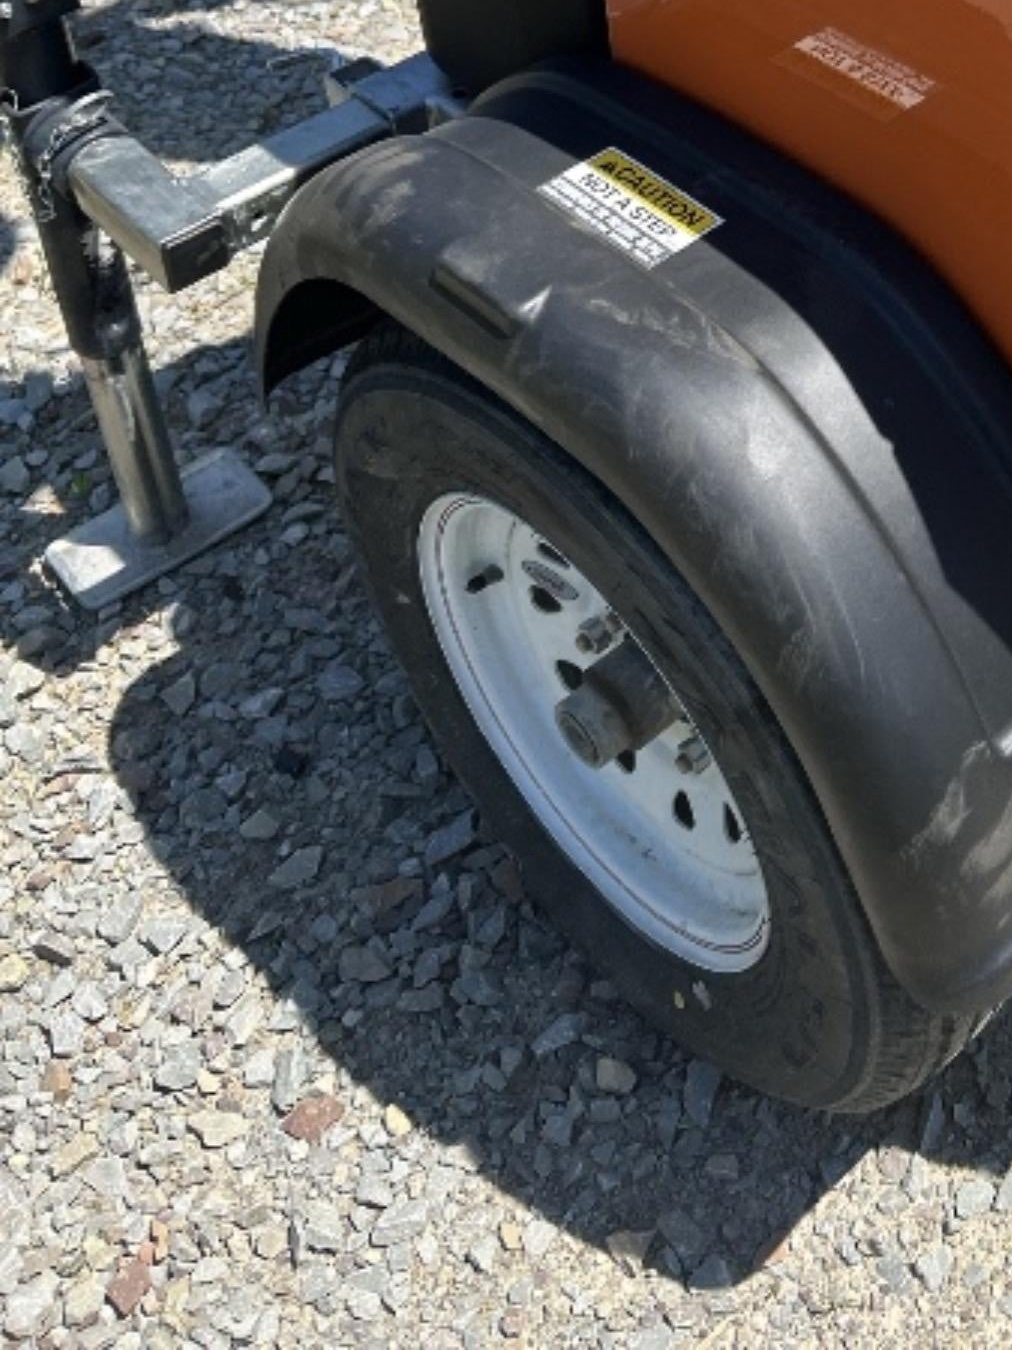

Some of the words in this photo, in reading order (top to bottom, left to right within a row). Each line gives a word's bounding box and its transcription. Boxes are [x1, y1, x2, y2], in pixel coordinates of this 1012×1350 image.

[578, 172, 622, 199] NOT
[614, 197, 631, 211] A
[629, 205, 677, 236] STEP
[613, 166, 706, 227] CAUTION
